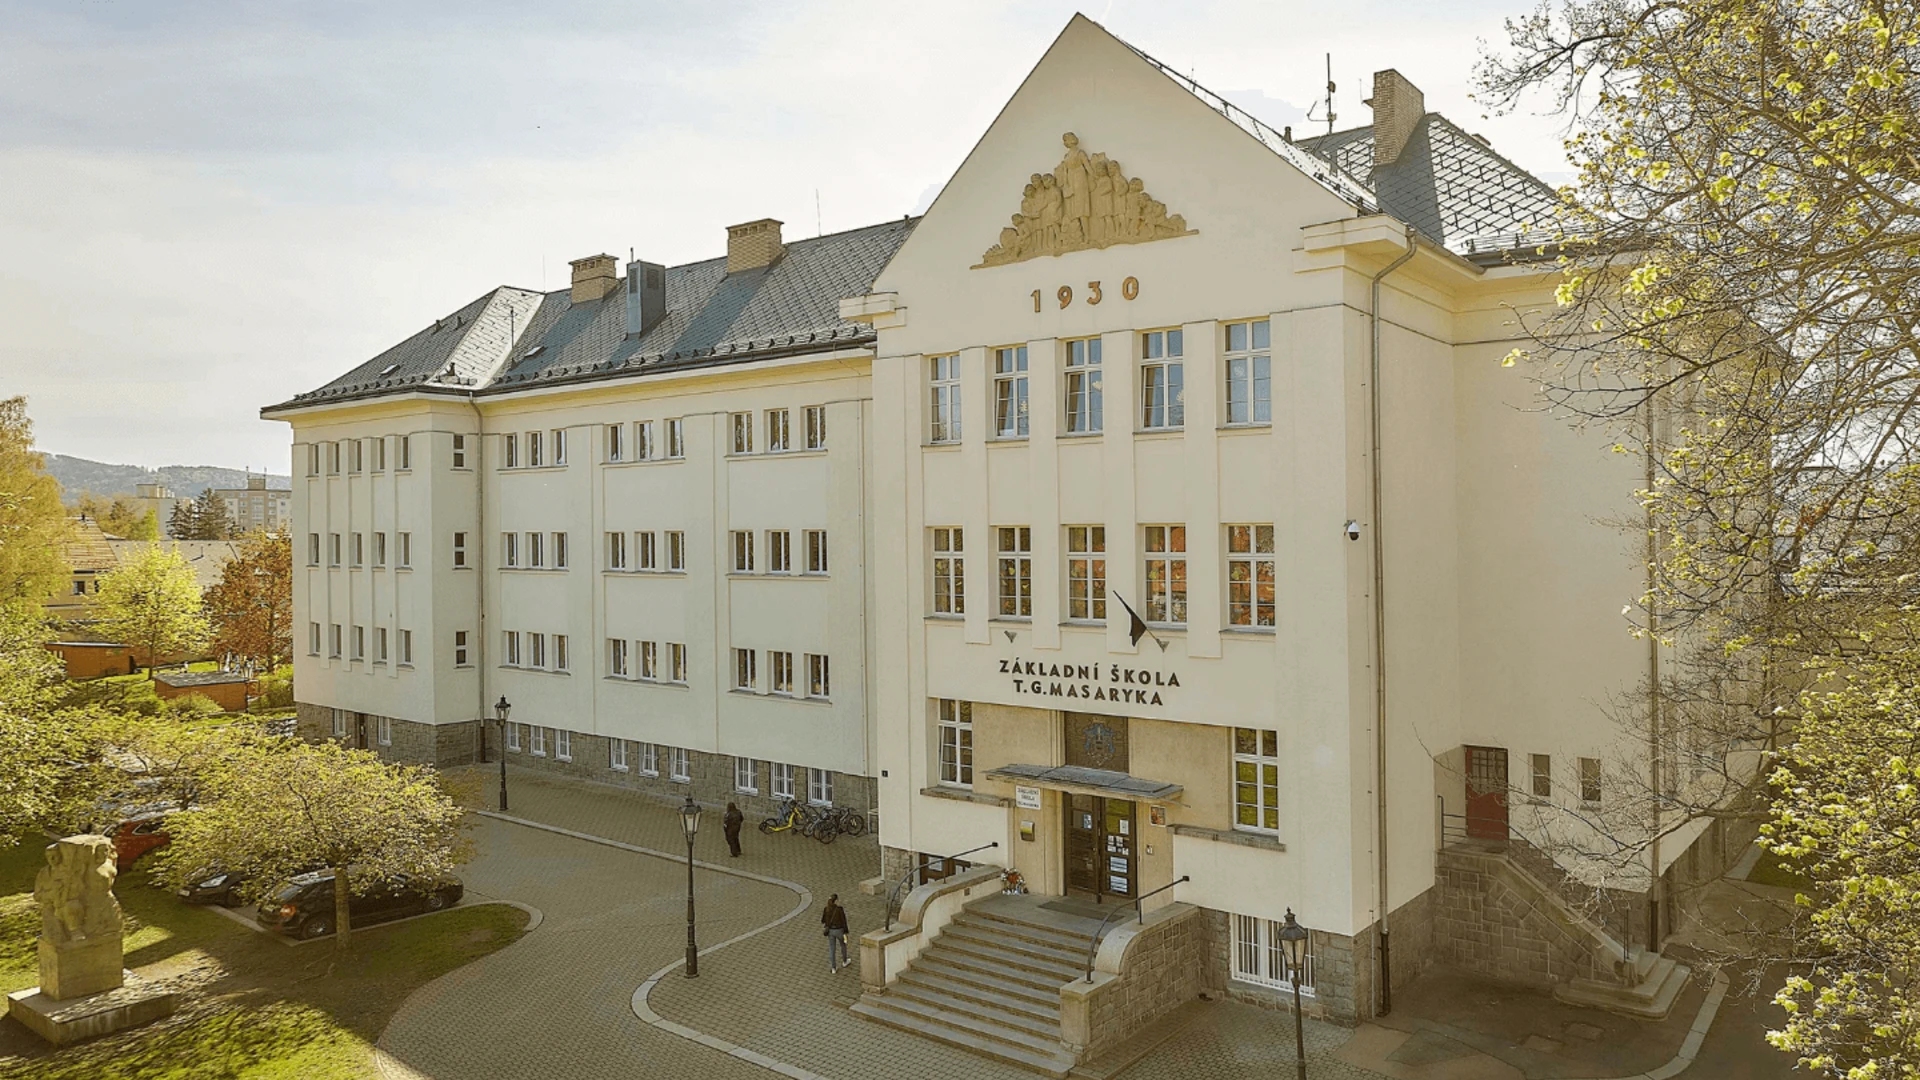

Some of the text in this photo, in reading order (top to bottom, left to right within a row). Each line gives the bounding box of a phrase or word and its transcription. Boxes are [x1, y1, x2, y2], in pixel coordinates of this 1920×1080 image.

[1030, 276, 1140, 313] 1930
[999, 657, 1181, 688] ZÁKLADNÍ ŠKOLA
